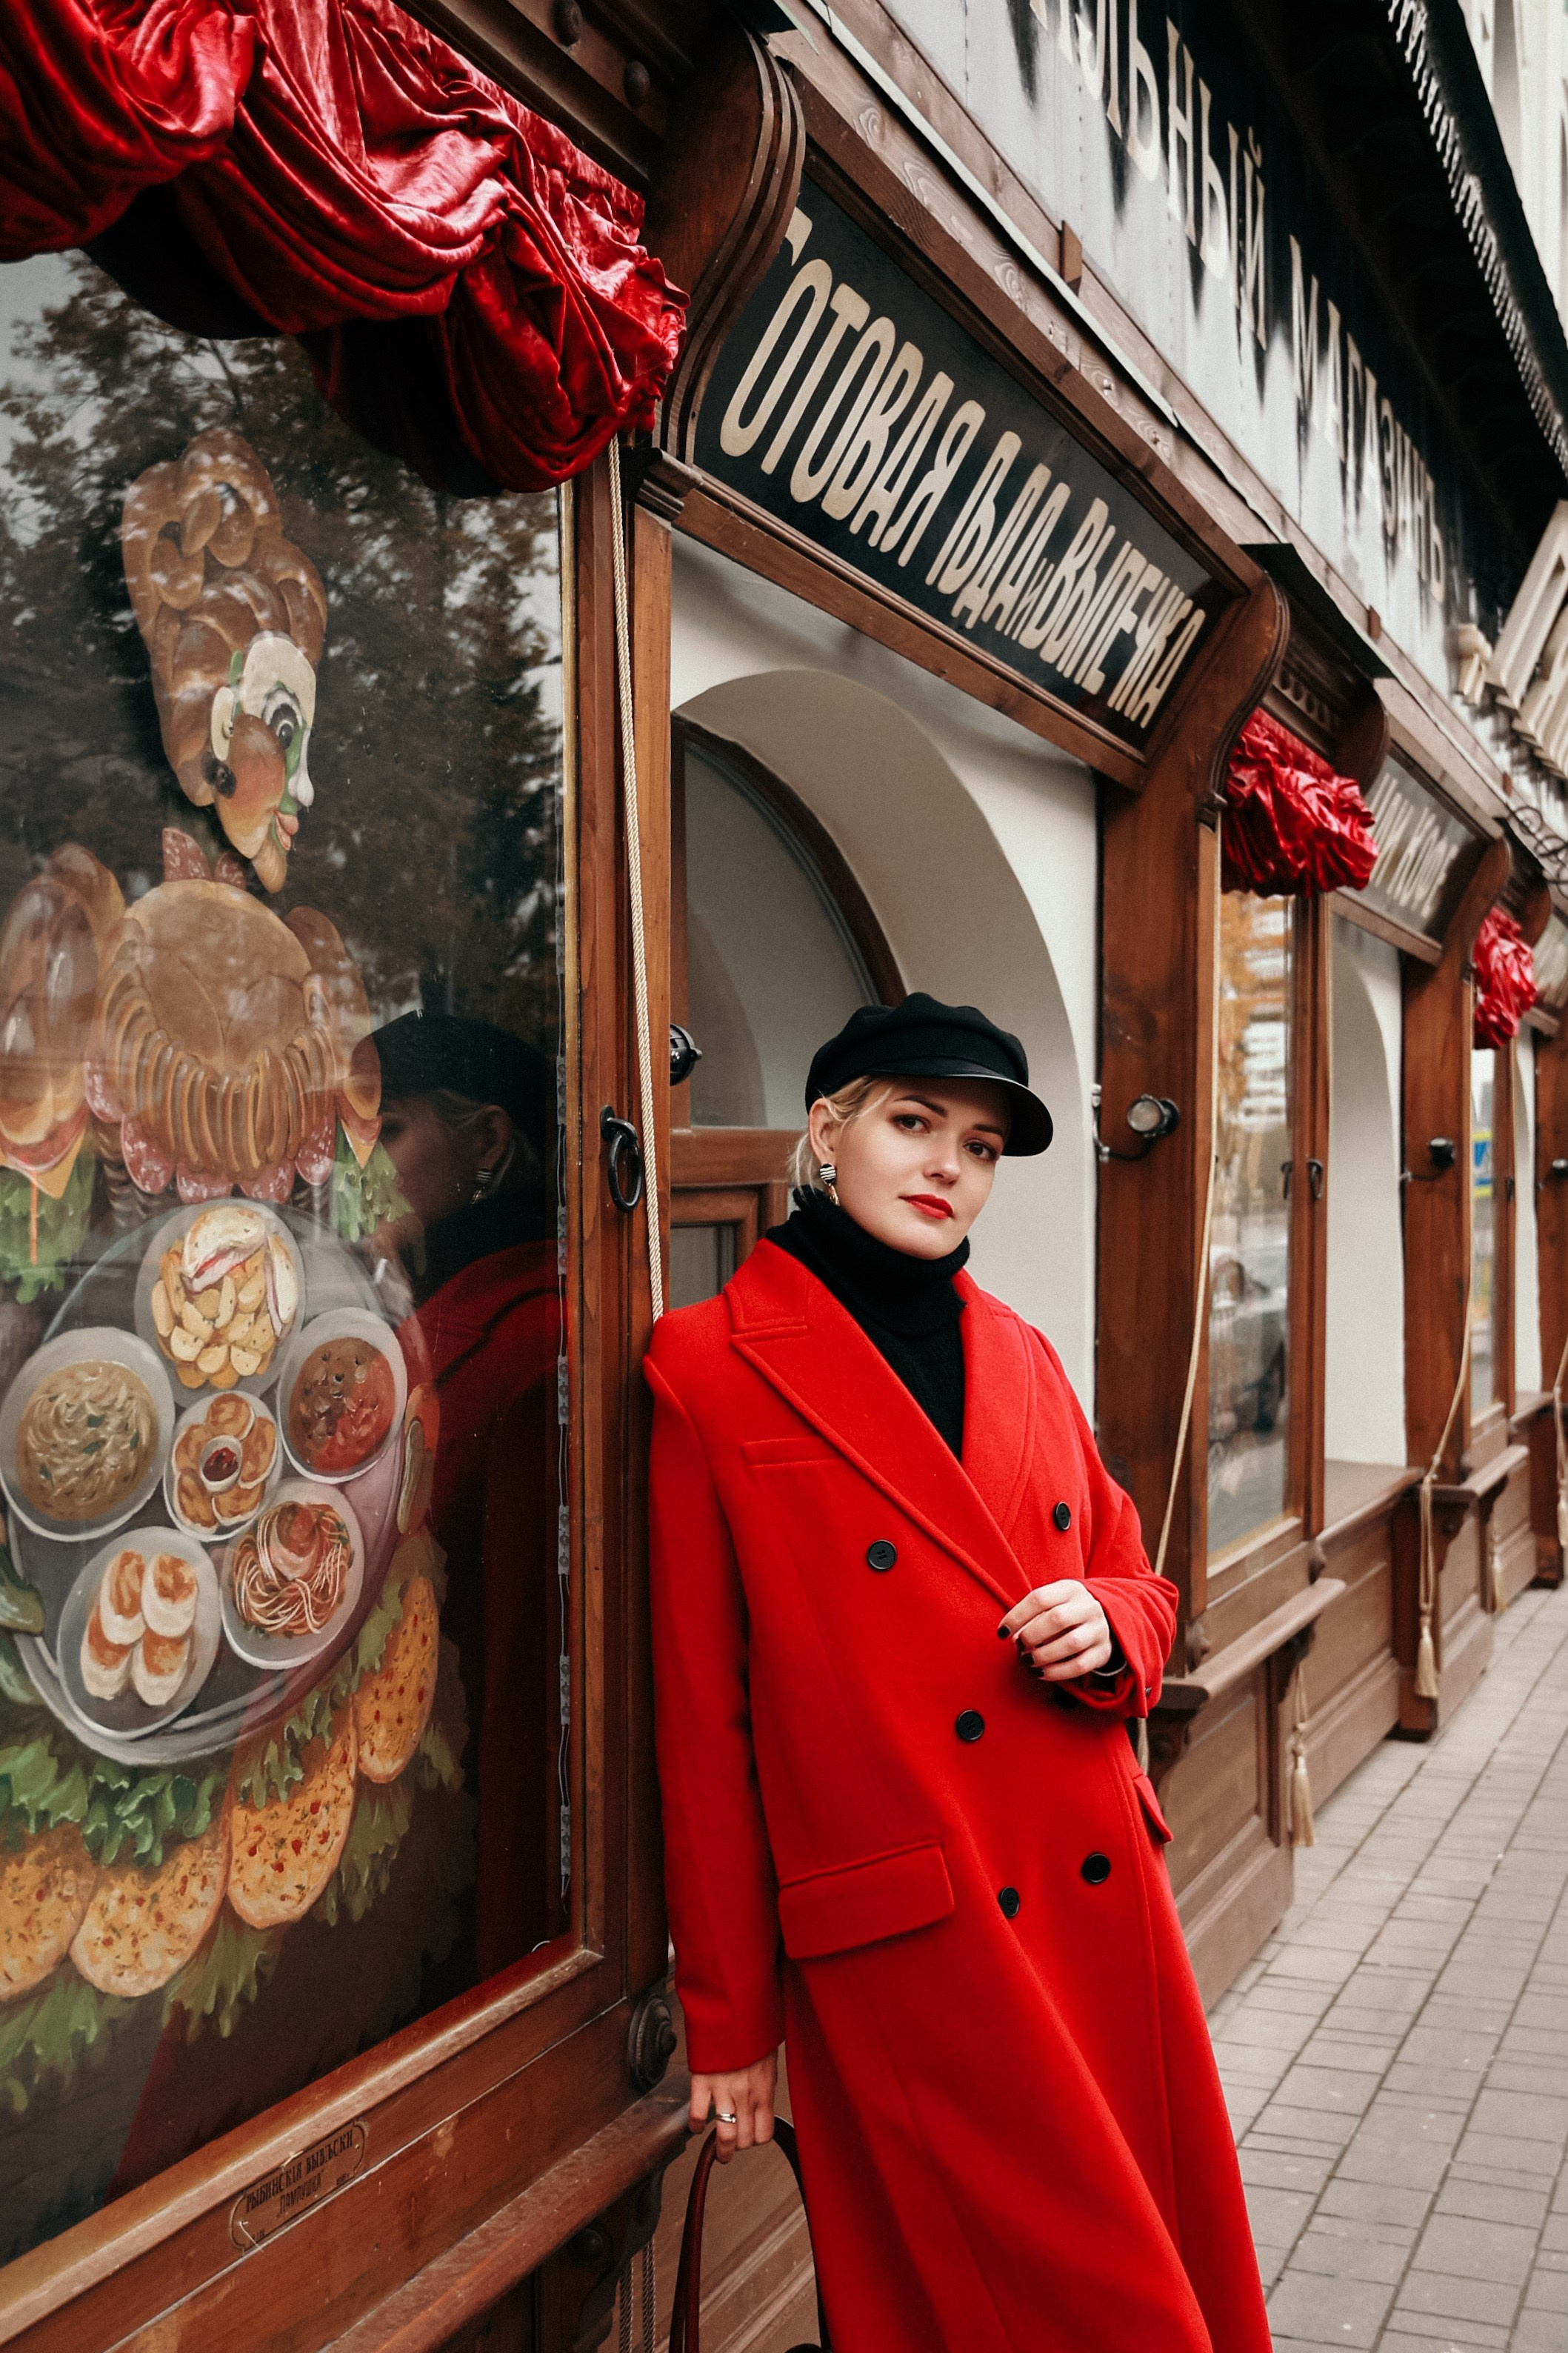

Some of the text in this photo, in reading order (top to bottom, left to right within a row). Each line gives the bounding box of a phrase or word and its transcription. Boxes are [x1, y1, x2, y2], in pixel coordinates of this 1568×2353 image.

[1030, 0, 1445, 604] ЛЬНЫЙ МАГАЗИНЪ
[1018, 496, 1206, 729] ВЫПЕЧКА
